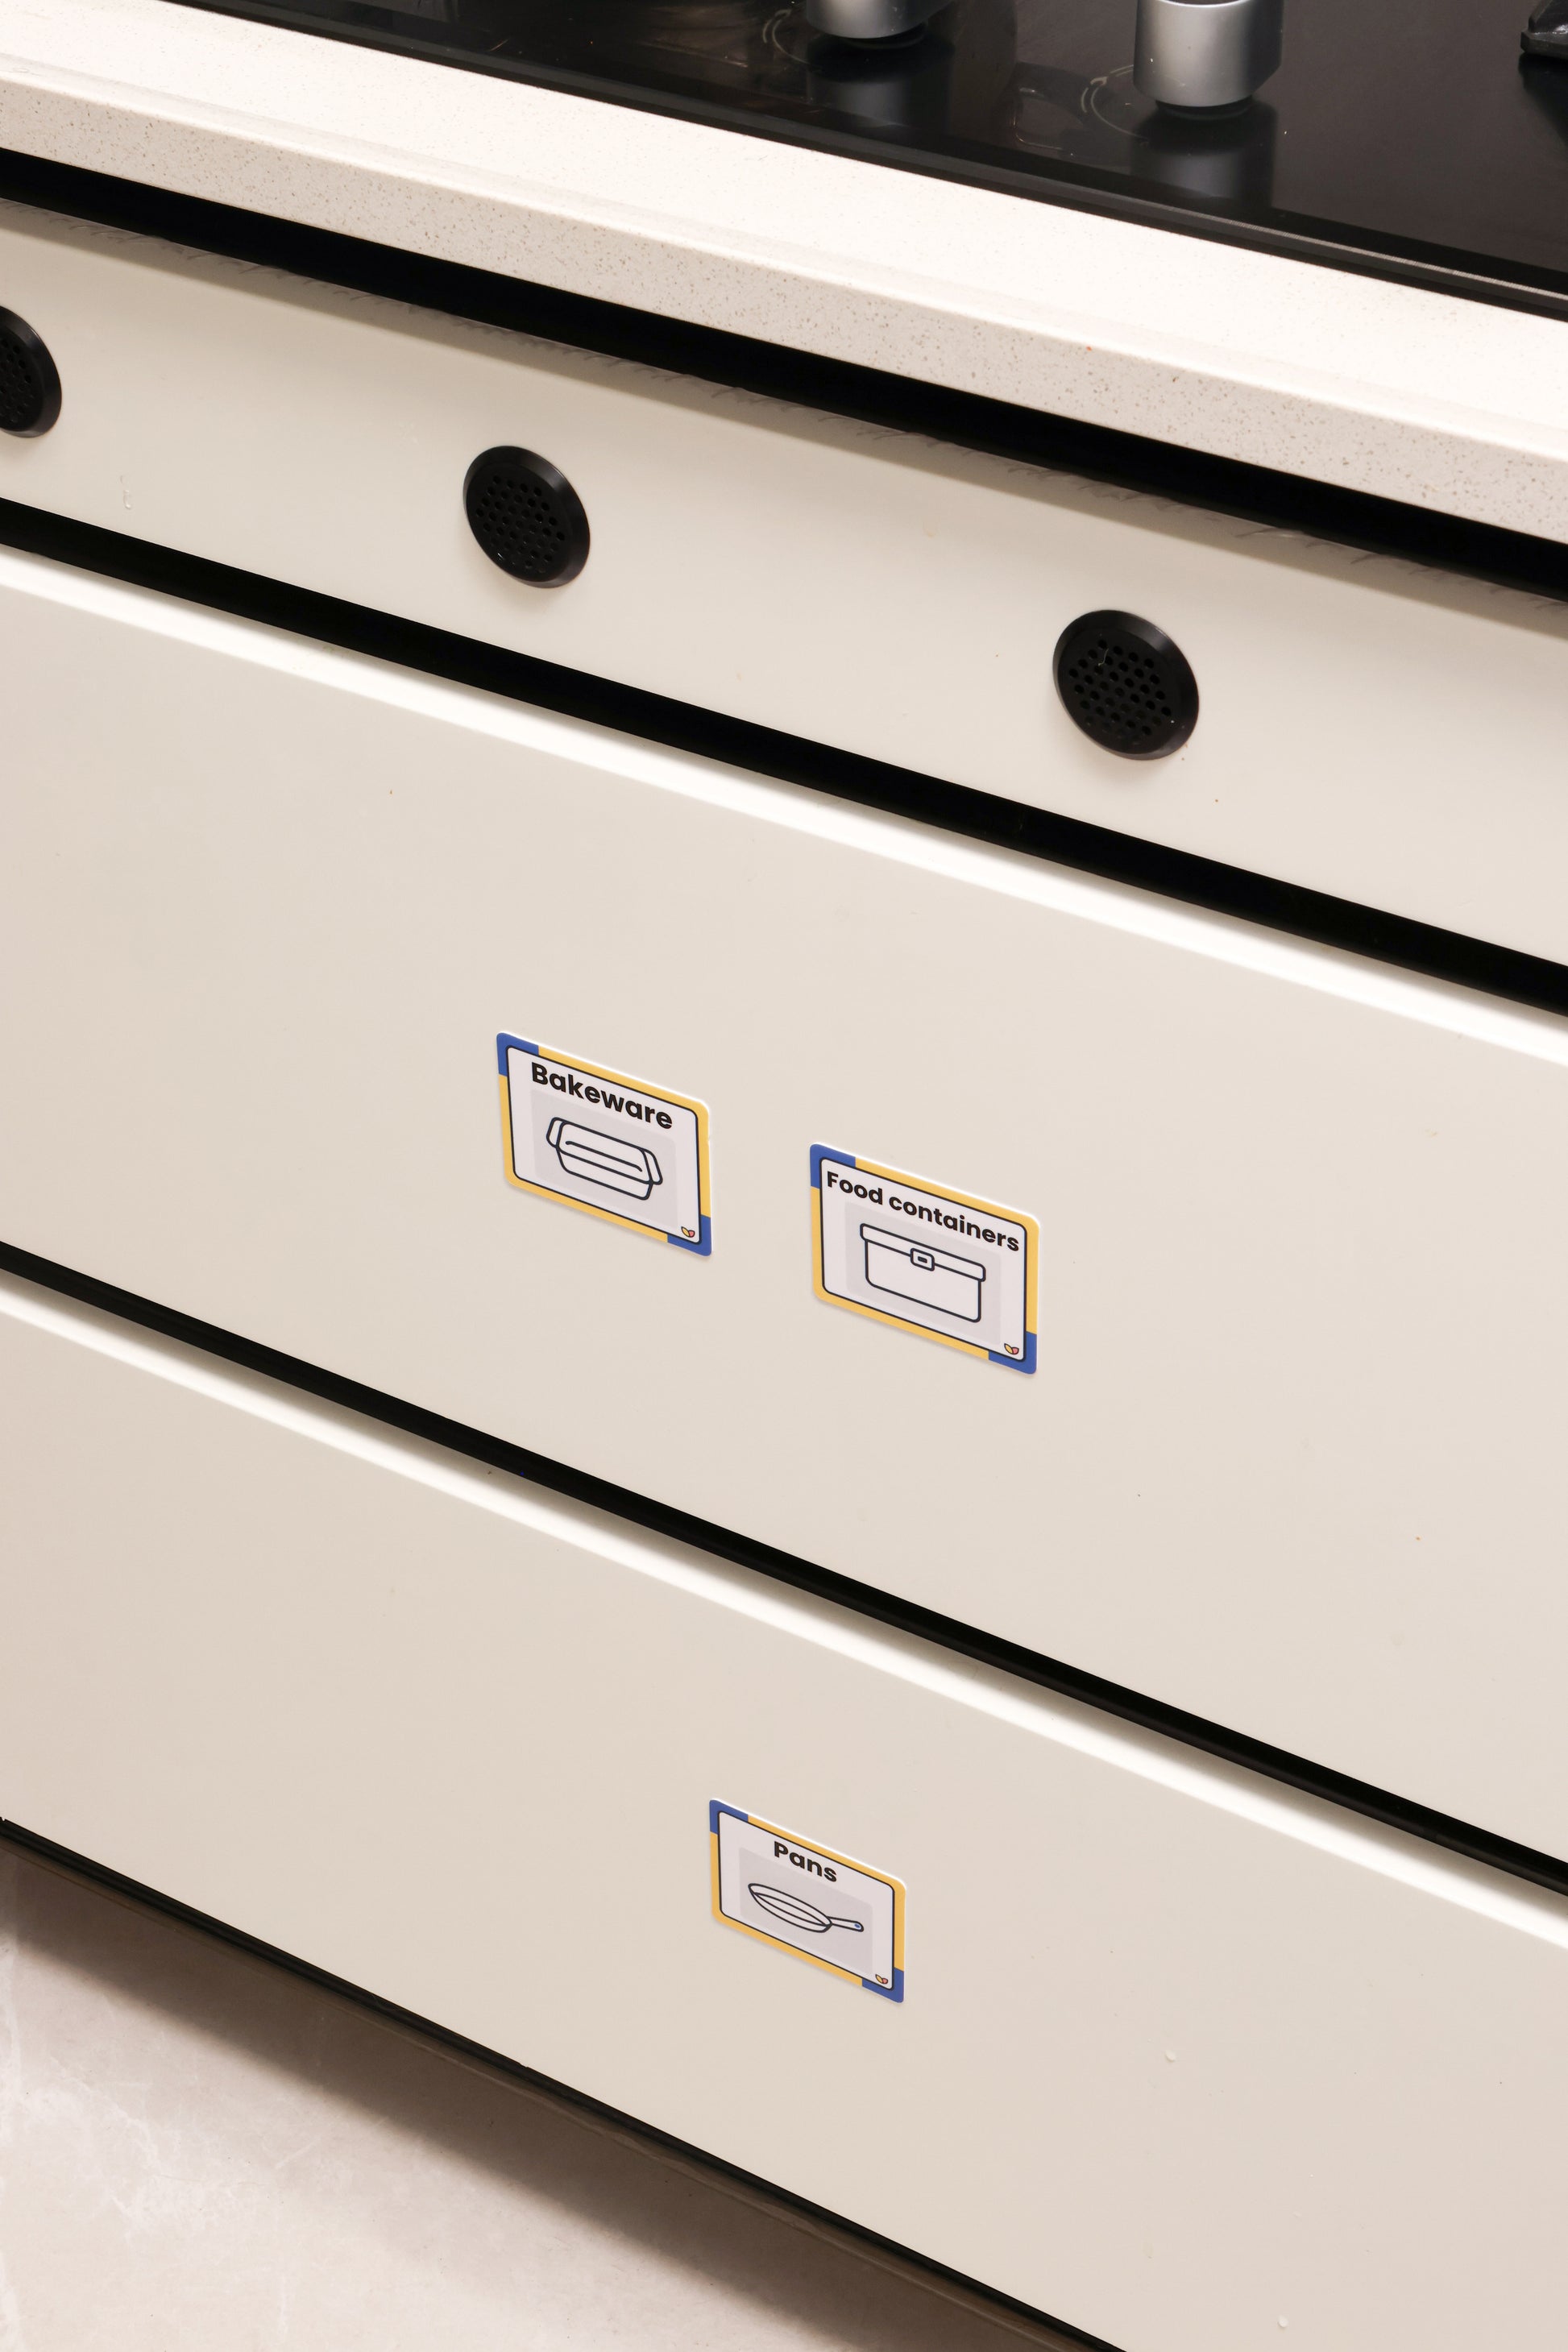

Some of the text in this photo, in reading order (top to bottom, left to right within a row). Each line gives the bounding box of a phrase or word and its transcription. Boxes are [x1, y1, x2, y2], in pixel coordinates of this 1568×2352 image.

[531, 1061, 673, 1130] Bakeware
[827, 1171, 1019, 1251] Food containers
[774, 1840, 837, 1882] Pans
